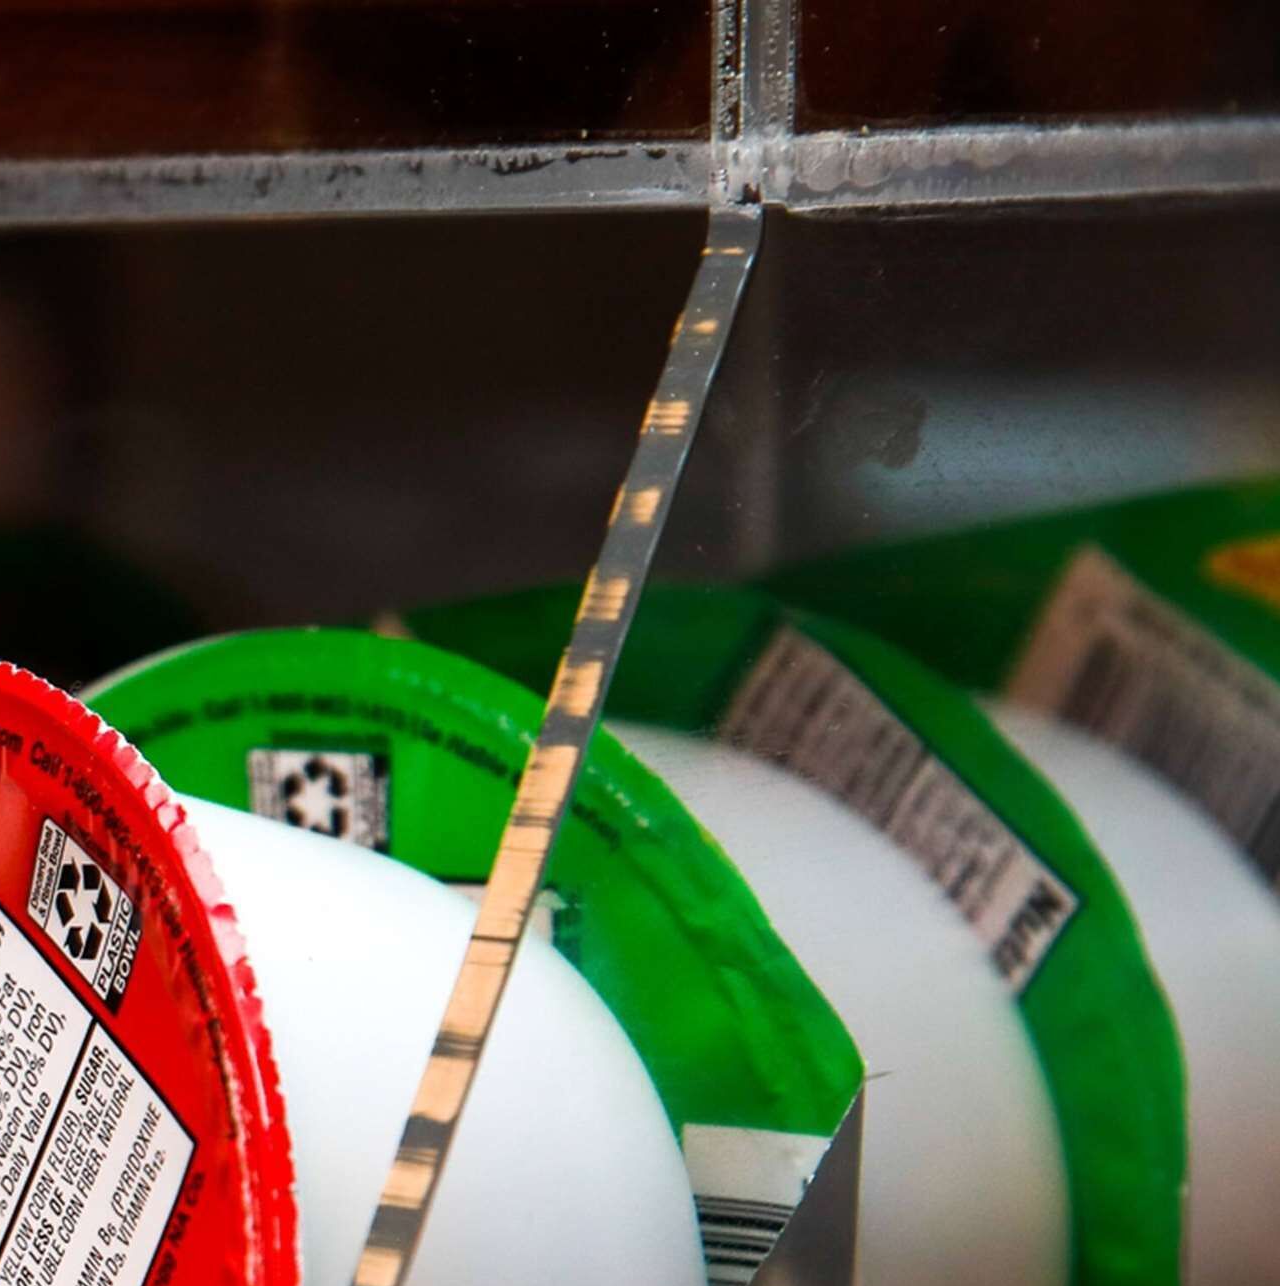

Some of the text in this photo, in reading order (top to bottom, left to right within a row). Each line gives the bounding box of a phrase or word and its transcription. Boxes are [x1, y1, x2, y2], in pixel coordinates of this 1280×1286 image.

[30, 826, 54, 910] Discard Seal
[97, 897, 133, 993] PLASTIC
[114, 928, 141, 994] BOWL
[2, 1046, 32, 1089] DV),
[22, 1002, 47, 1043] Iron
[6, 987, 36, 1030] DV),
[16, 1053, 47, 1108] (10%
[37, 1011, 67, 1055] DV),
[0, 1145, 30, 1197] Daily
[20, 1091, 52, 1144] Value
[27, 1169, 55, 1221] CORN
[46, 1109, 84, 1174] FLOUR),
[74, 1045, 110, 1107] SUGAR,
[28, 1217, 55, 1266] LESS
[48, 1186, 66, 1217] OF
[60, 1089, 108, 1186] VEGETABLE
[100, 1057, 122, 1089] OIL
[57, 1193, 85, 1245] CORN
[75, 1147, 108, 1200] FIBER,
[96, 1073, 135, 1149] NATURAL
[110, 1101, 162, 1219] (PYRIDOXINE
[116, 1176, 152, 1247] VITAMIN
